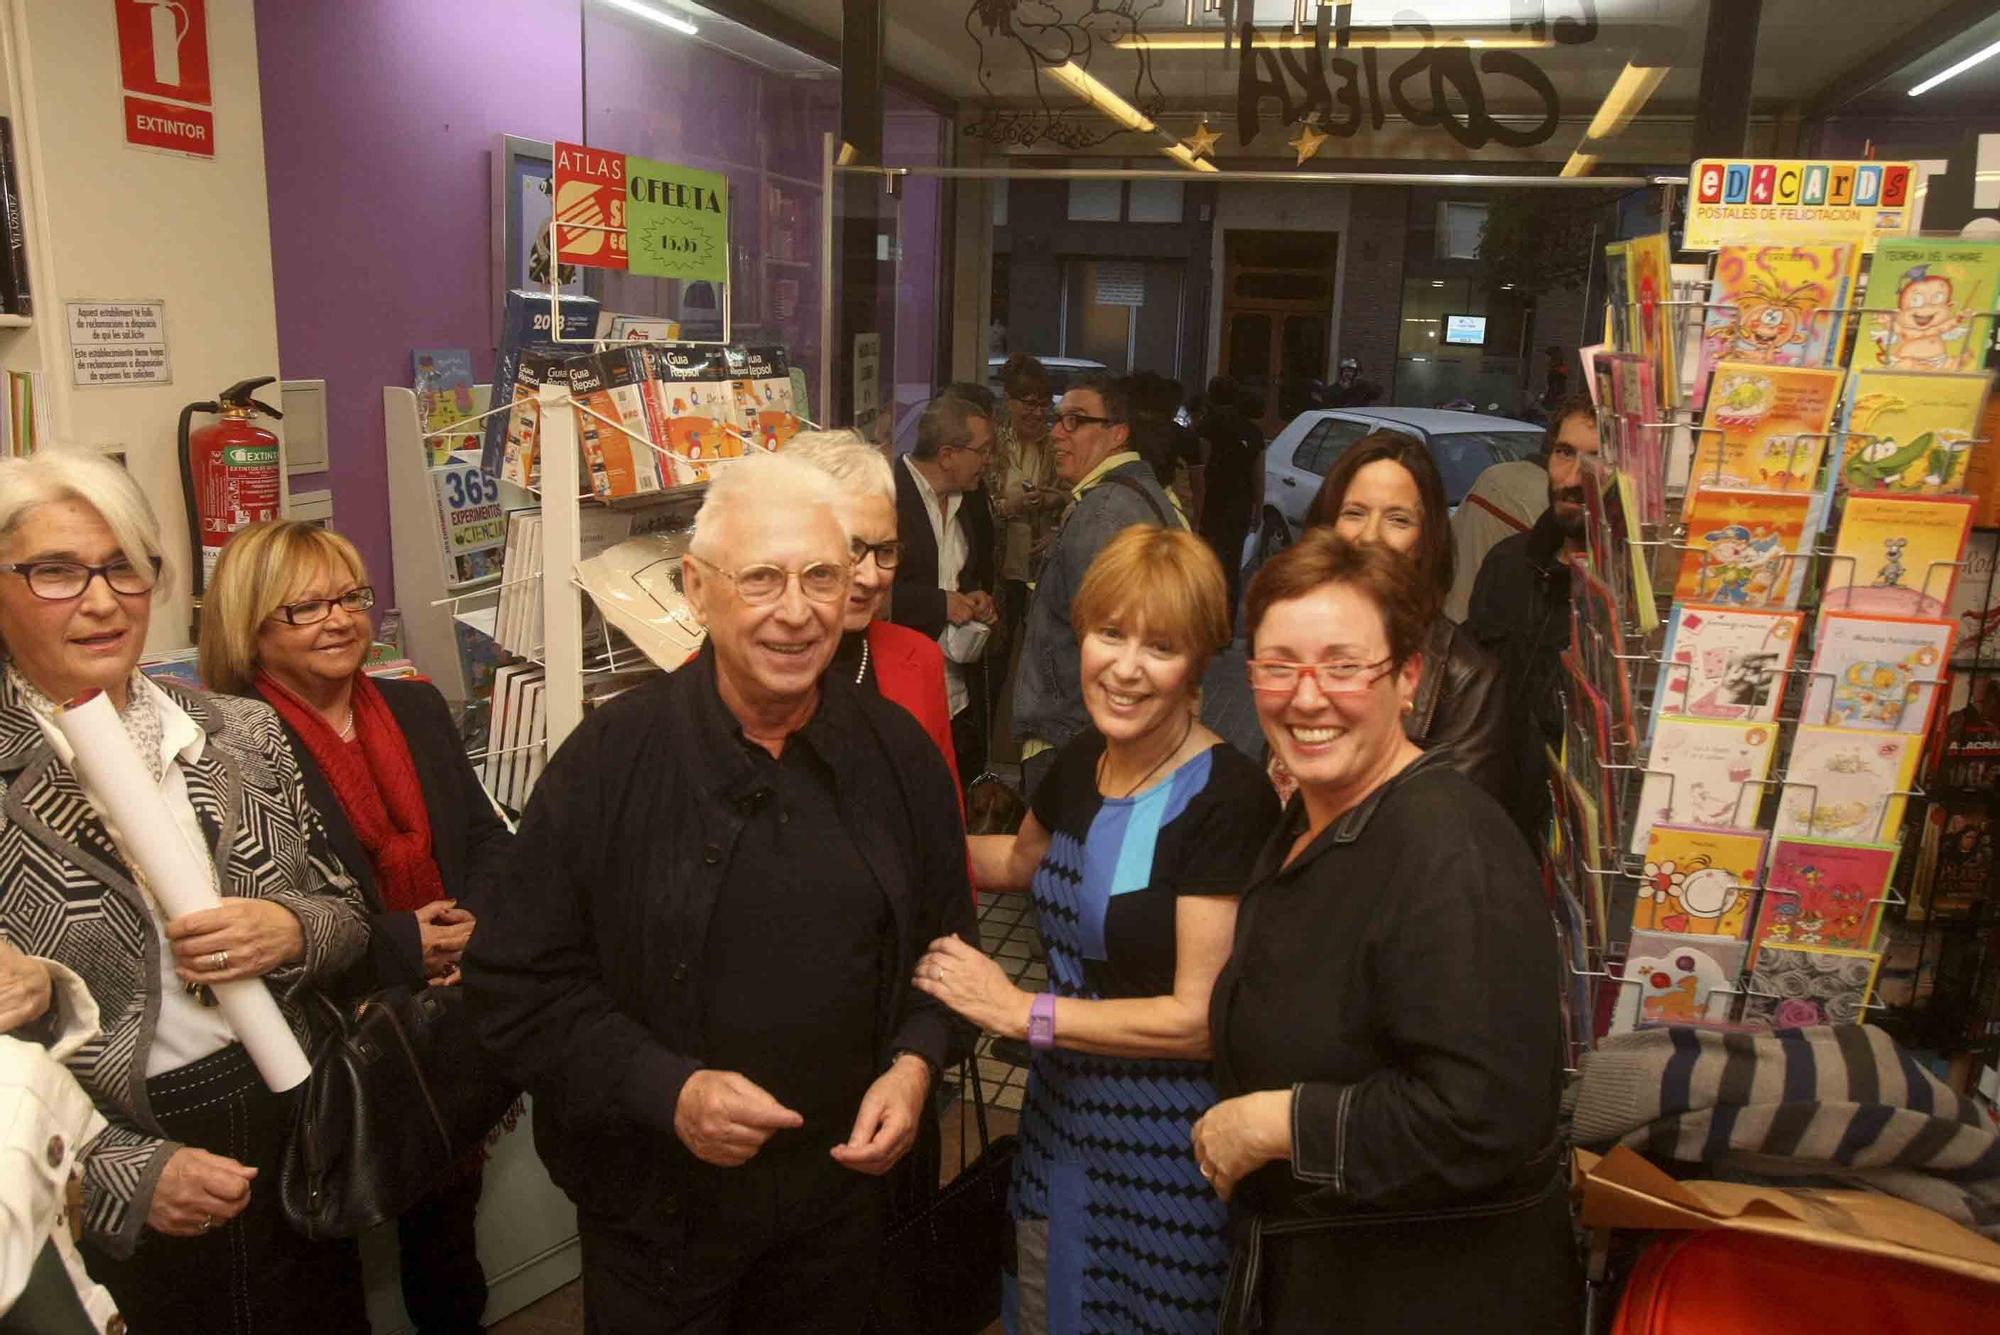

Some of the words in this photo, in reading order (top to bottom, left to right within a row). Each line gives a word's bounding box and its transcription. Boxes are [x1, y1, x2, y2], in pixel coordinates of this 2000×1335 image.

[136, 115, 205, 140] EXTINTOR
[558, 149, 621, 180] ATLAS
[631, 176, 721, 213] OFERTA
[1697, 208, 1757, 220] POSTALES
[1760, 208, 1776, 220] DE
[533, 314, 565, 330] 203
[569, 368, 590, 380] Guia
[572, 375, 600, 392] Repsol
[446, 469, 498, 508] 365
[451, 504, 502, 526] EXPERIMENTOS
